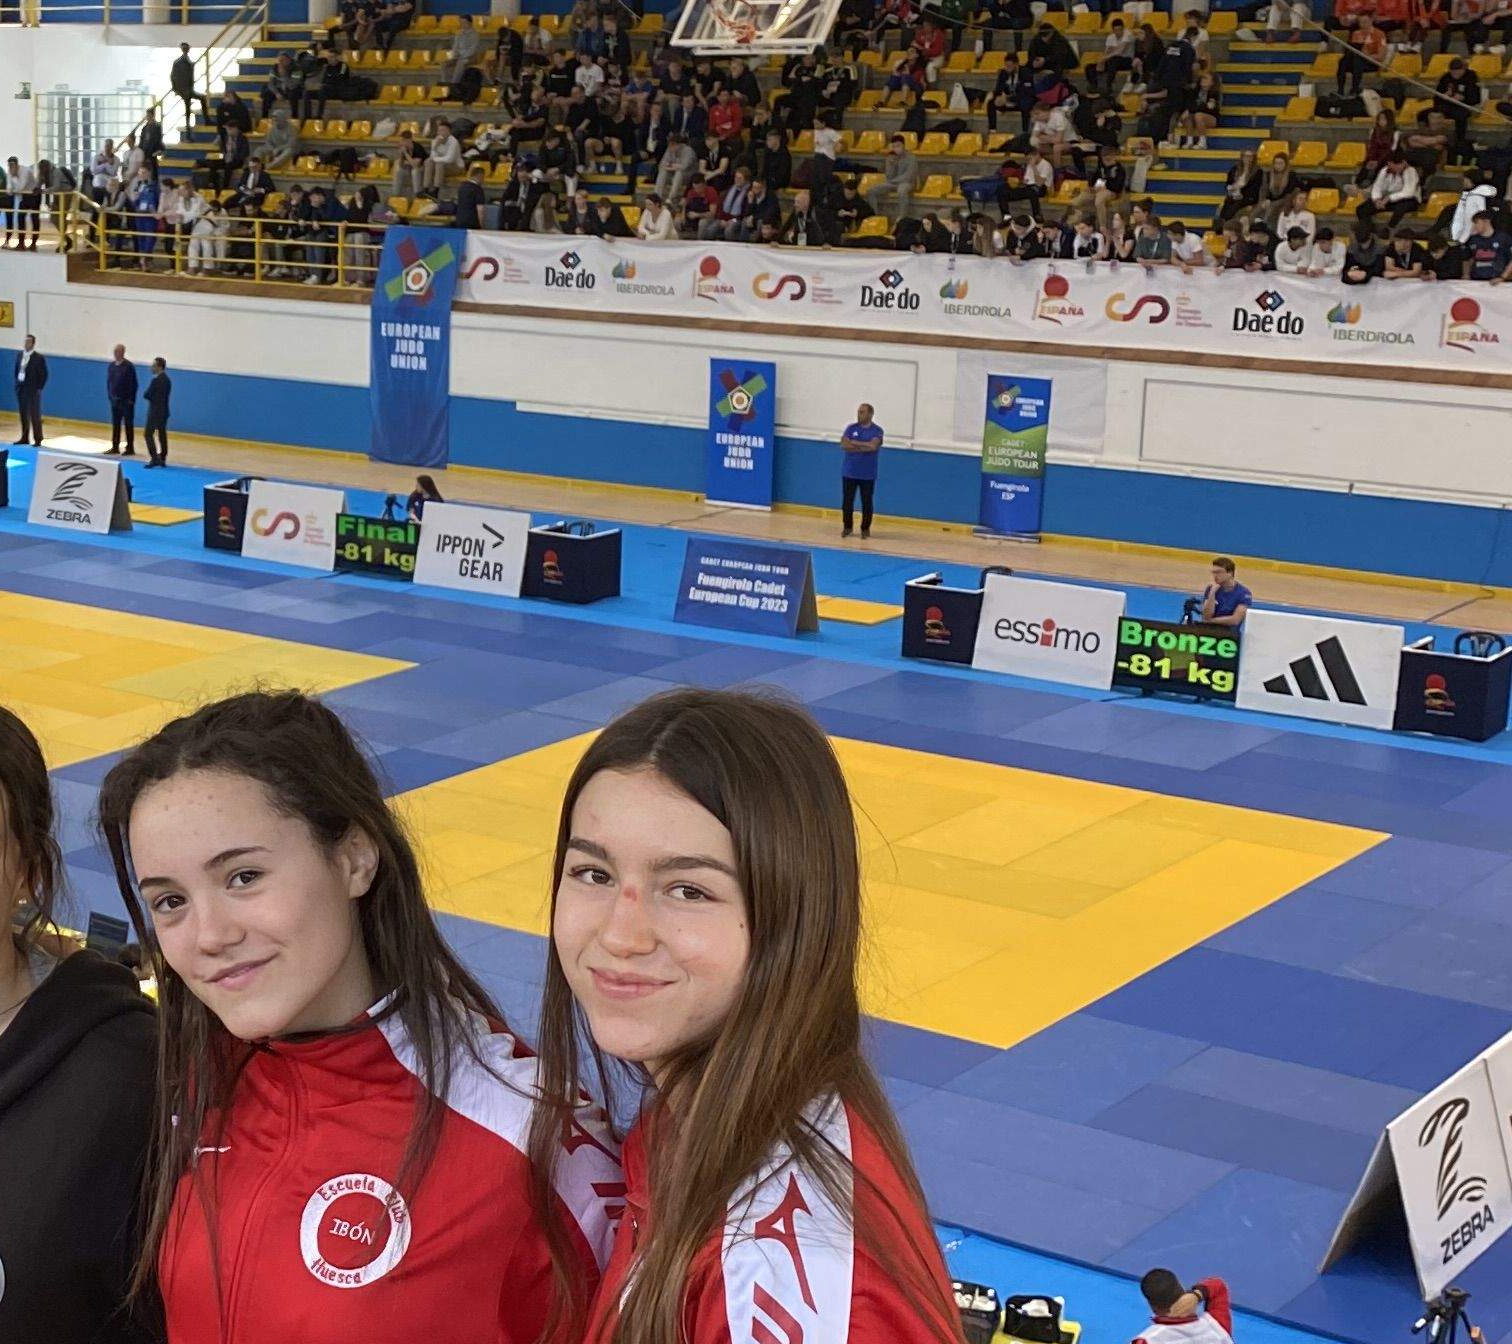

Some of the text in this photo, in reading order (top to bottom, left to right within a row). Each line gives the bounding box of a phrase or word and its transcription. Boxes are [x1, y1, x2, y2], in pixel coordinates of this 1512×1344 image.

[616, 283, 675, 296] IBERDROLA
[943, 304, 1012, 318] IBERDROLA
[380, 322, 441, 341] EUROPEAN
[1333, 329, 1415, 345] IBERDROLA
[394, 338, 425, 355] JUDO
[390, 353, 427, 371] UNION
[715, 432, 765, 449] EUROPEAN
[727, 445, 752, 458] JUDO
[723, 456, 754, 471] UNION
[987, 457, 1040, 470] JUDO TOUR
[988, 446, 1038, 460] EUROPEAN
[46, 508, 92, 525] ZEBRA
[338, 514, 417, 545] Final
[436, 533, 485, 557] IPPON
[335, 544, 415, 572] -81 kg
[458, 558, 504, 582] GEAR
[697, 572, 786, 596] Fuengirola Cadet
[689, 587, 789, 613] European Cup 2023
[993, 618, 1101, 654] essimo
[1119, 620, 1238, 658] Bronze
[1117, 654, 1235, 693] -81 kg
[317, 1175, 376, 1202] Escuela
[328, 1217, 376, 1246] IBÓN
[1439, 1204, 1495, 1265] ZEBRA
[310, 1257, 363, 1285] Huesca
